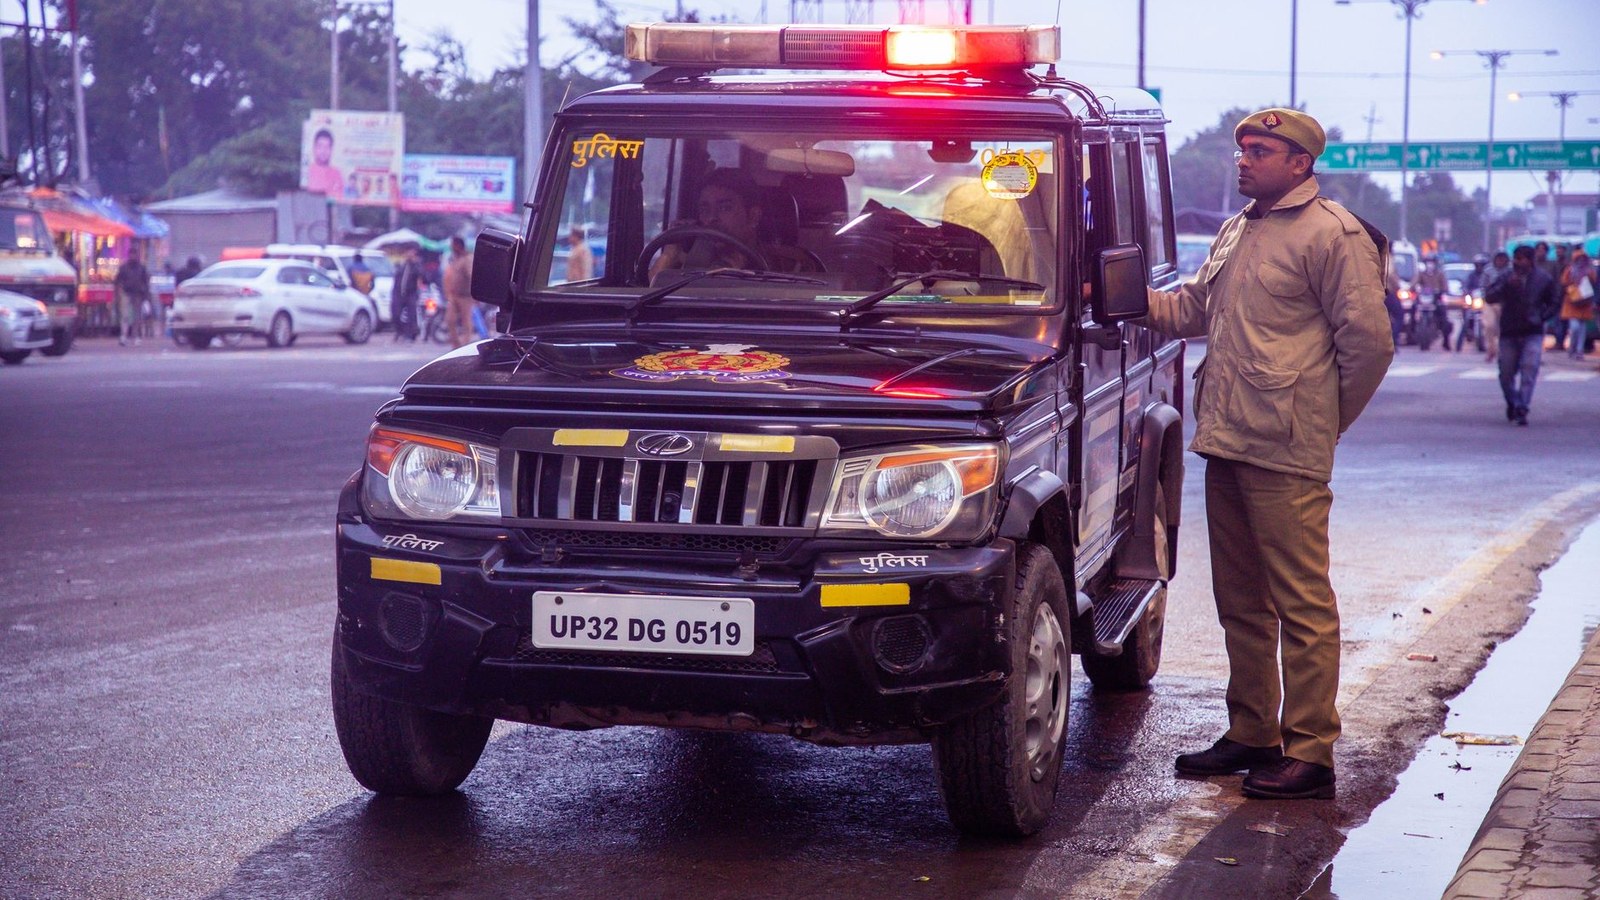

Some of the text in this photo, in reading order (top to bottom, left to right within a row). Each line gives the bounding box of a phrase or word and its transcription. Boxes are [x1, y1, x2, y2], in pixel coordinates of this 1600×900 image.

[571, 132, 645, 168] पुलिस
[859, 552, 929, 574] पुलिस
[550, 614, 742, 646] UP32 DG 0519
